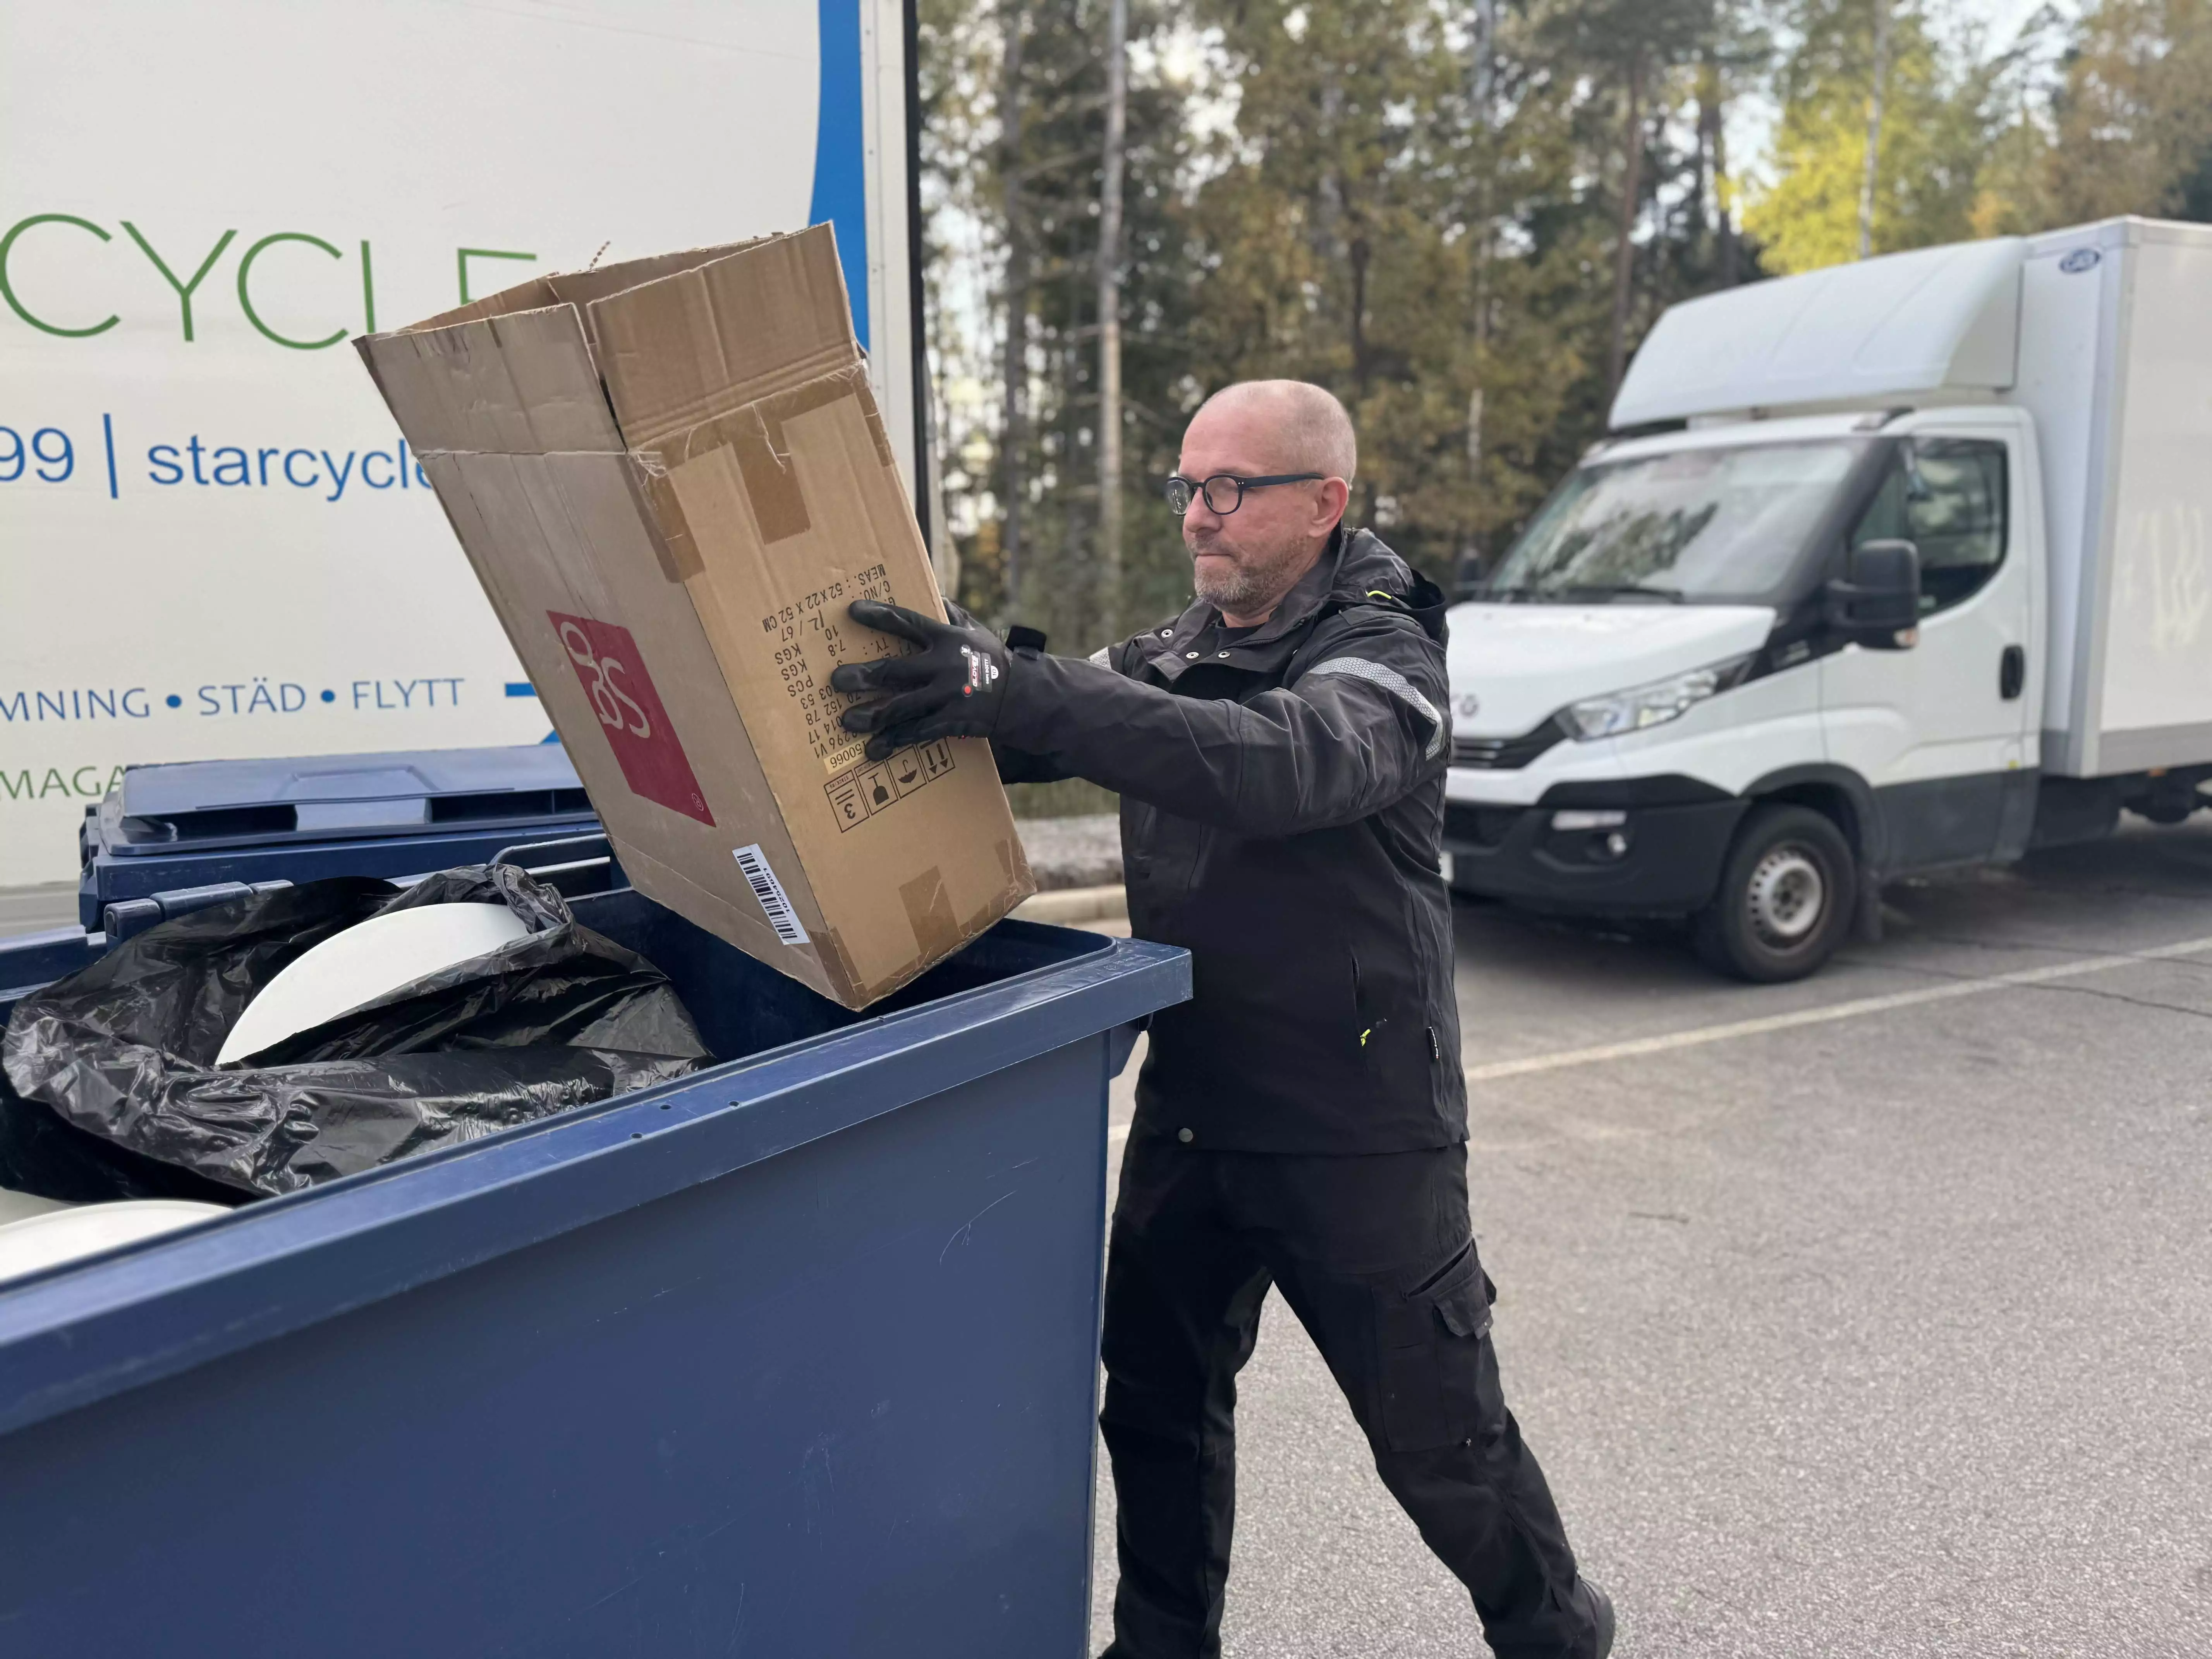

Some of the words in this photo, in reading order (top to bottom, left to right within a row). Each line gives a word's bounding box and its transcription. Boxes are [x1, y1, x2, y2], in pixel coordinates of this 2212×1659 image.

[778, 607, 794, 623] 52
[762, 615, 777, 632] CM
[781, 626, 793, 642] 67
[825, 625, 838, 640] 10
[775, 643, 801, 665] KGS
[828, 640, 846, 656] 7.8
[781, 659, 807, 680] KGS
[788, 675, 814, 697] PCS
[0, 688, 150, 721] MNING
[198, 677, 306, 716] STÄD
[352, 678, 465, 709] FLYTT
[800, 694, 814, 709] 53
[824, 699, 842, 715] 152
[806, 709, 821, 725] 78
[809, 730, 820, 744] 17
[814, 743, 828, 759] V1
[844, 803, 855, 819] 3
